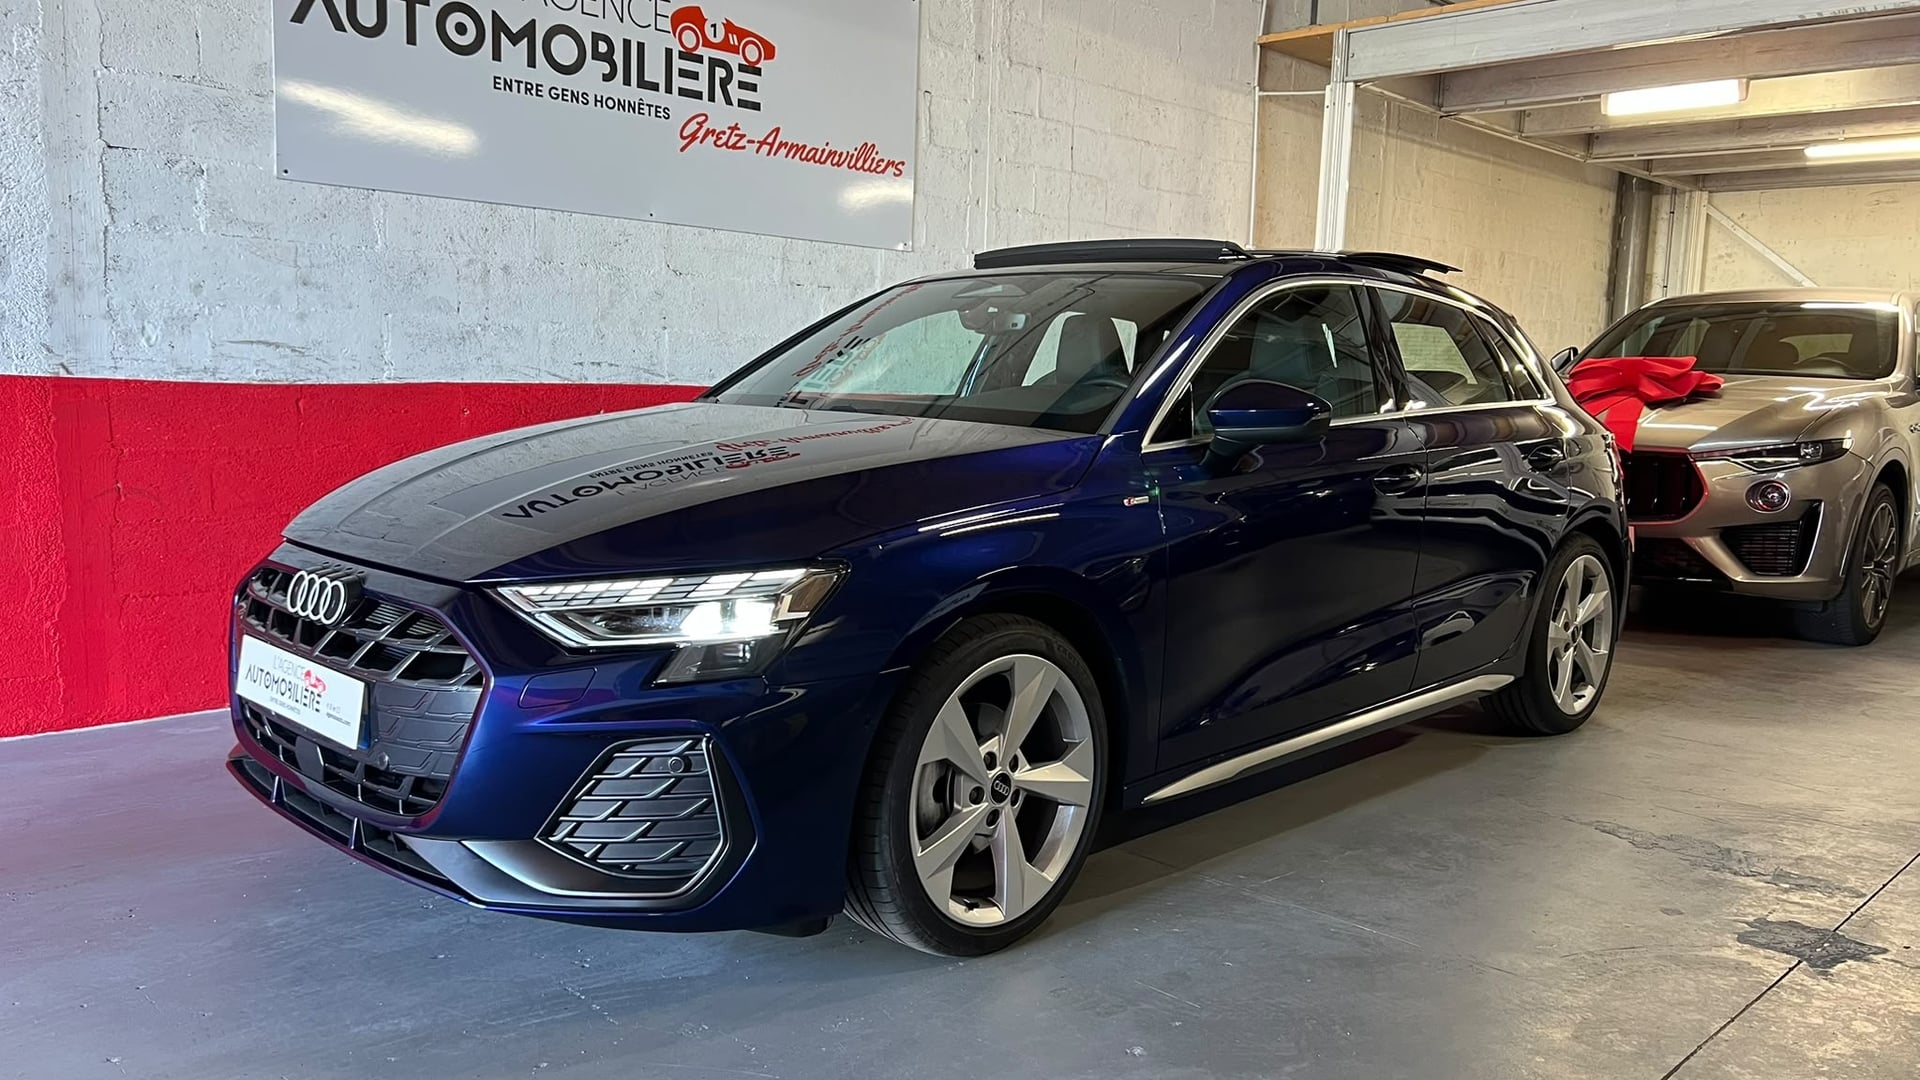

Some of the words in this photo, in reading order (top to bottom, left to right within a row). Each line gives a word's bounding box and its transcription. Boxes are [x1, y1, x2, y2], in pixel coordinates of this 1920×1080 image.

[710, 23, 717, 38] 1
[493, 76, 543, 97] ENTRE
[548, 86, 590, 105] GENS
[594, 94, 671, 120] HONNÊTES
[679, 113, 906, 178] Gretz-Armainvilliers
[245, 664, 322, 713] AUTOMOBILIERE
